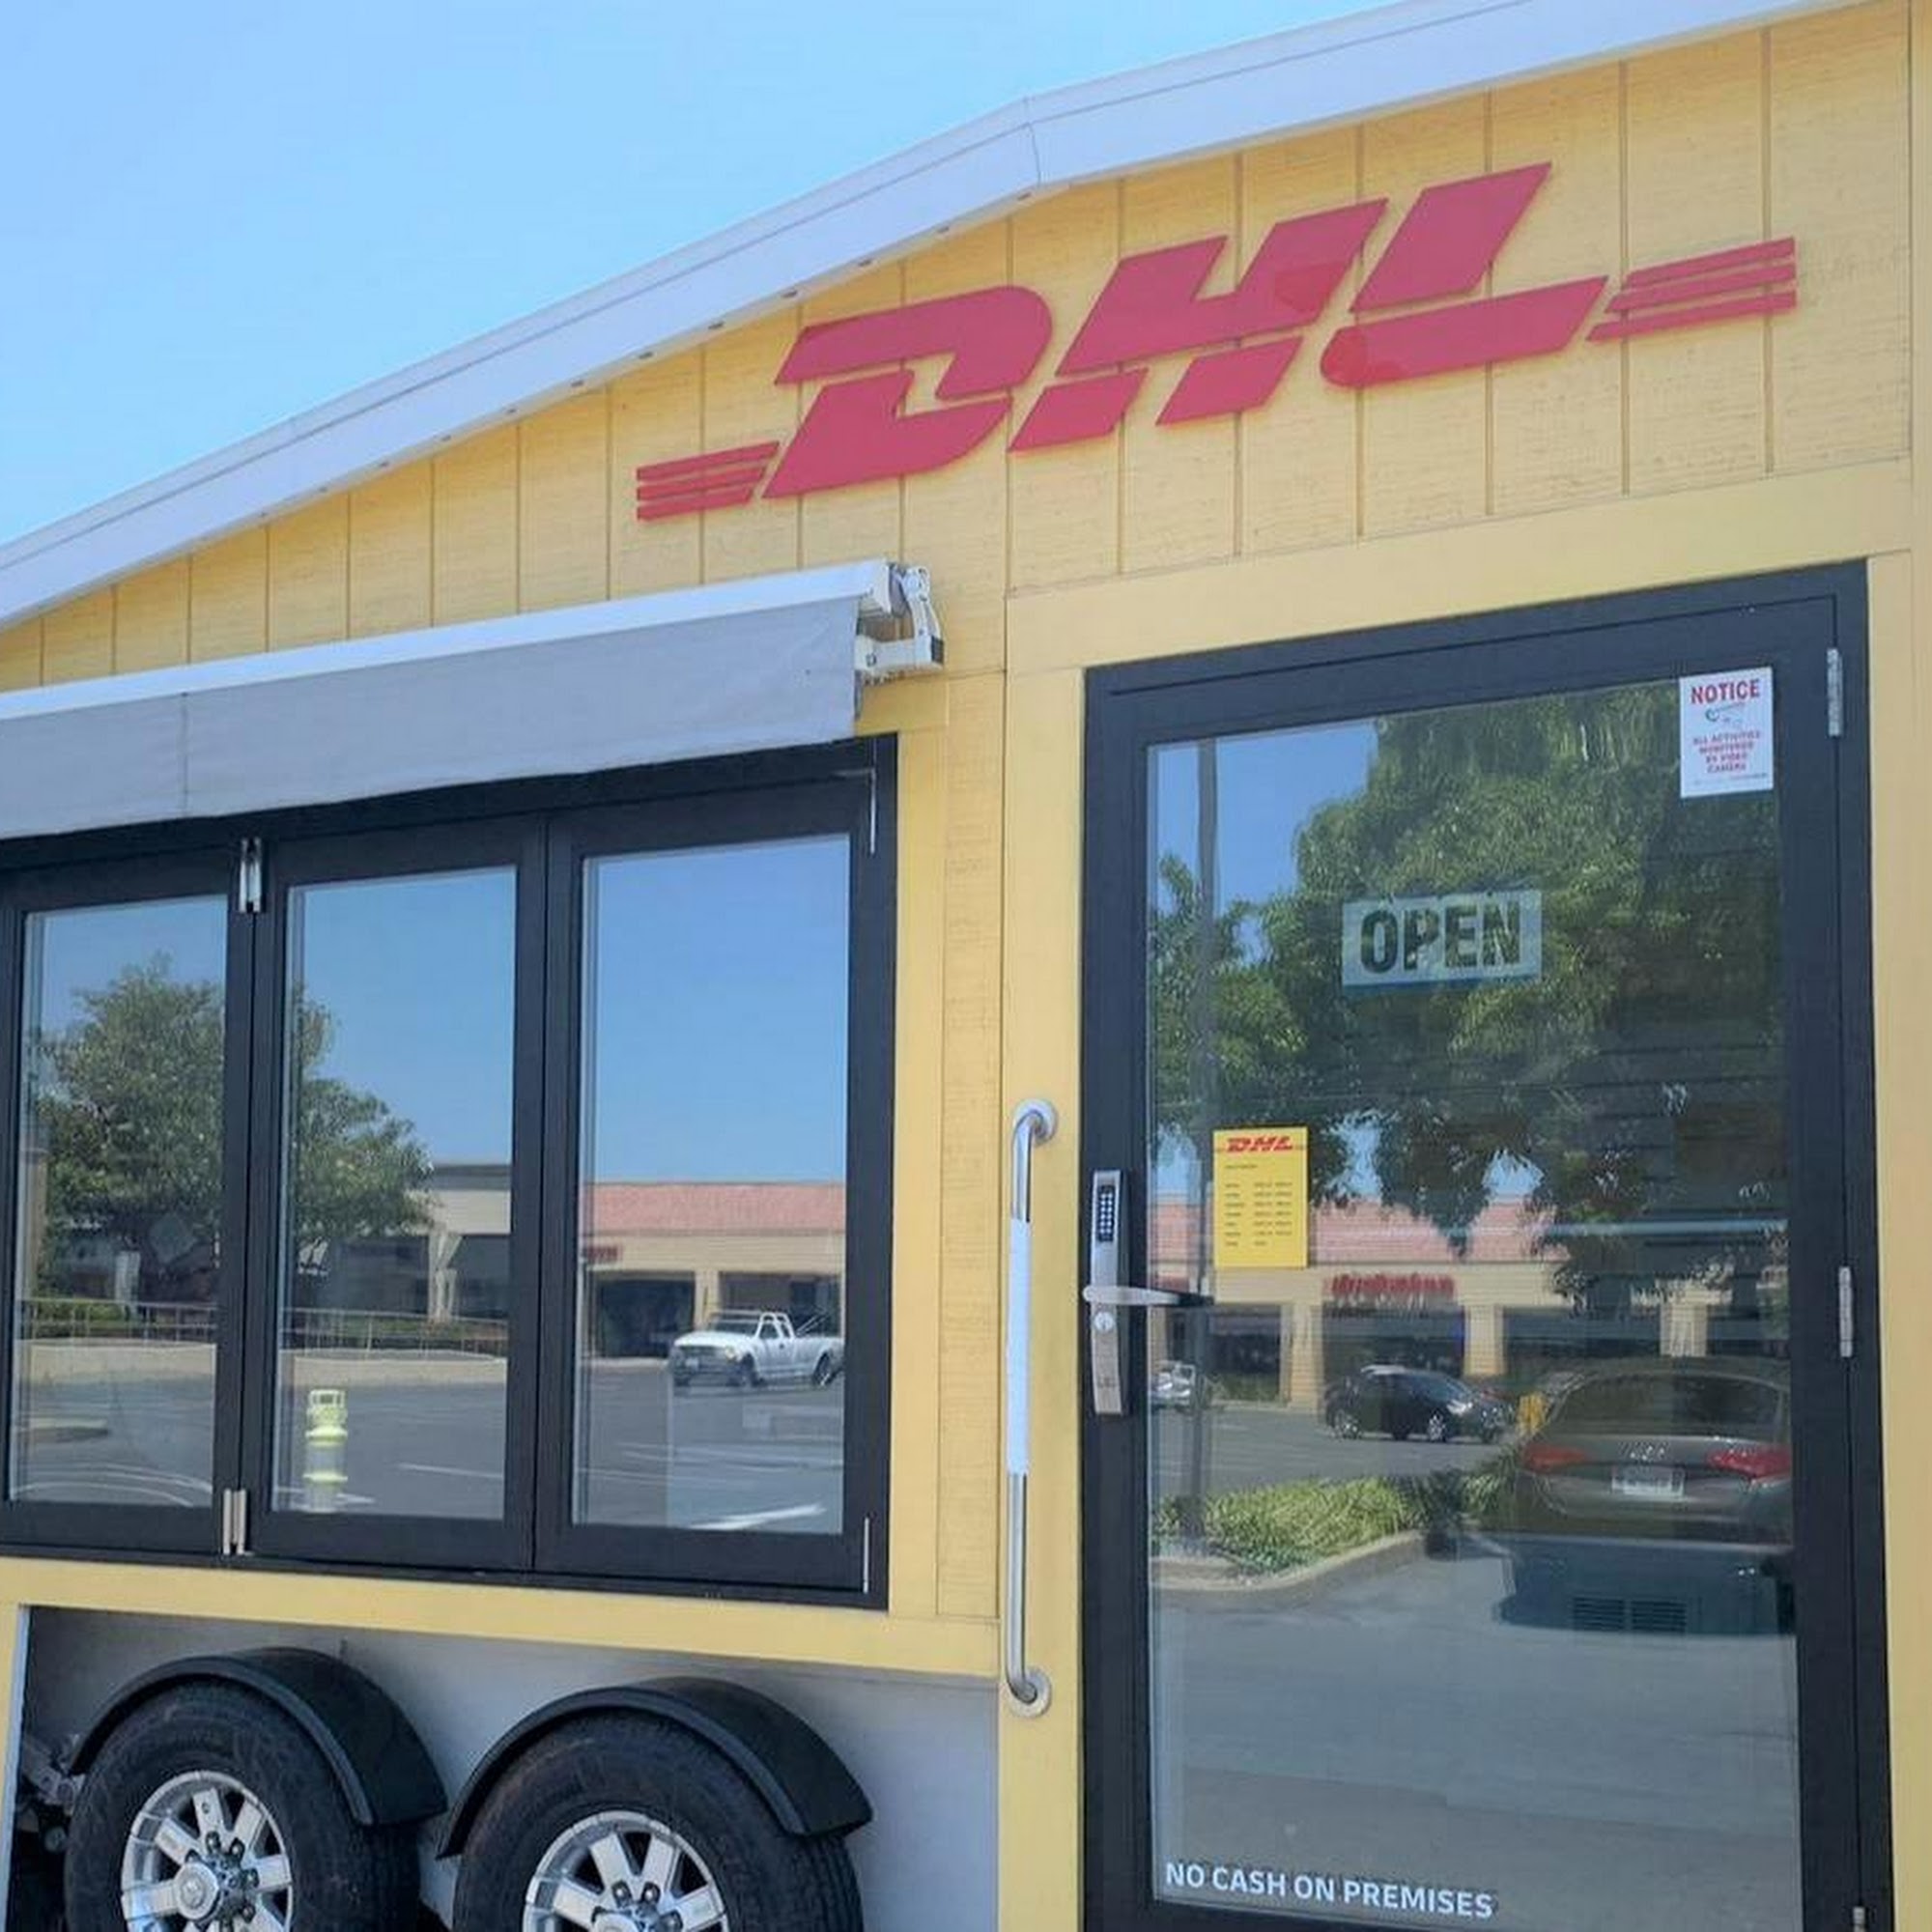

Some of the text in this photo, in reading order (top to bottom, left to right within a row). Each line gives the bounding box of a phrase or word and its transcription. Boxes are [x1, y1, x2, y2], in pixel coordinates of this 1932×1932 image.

[761, 161, 1607, 499] DHL
[1690, 678, 1761, 703] NOTICE
[1360, 901, 1521, 974] OPEN
[1226, 1135, 1293, 1152] DHL
[1166, 1862, 1493, 1918] NO CASH ON PREMISES
